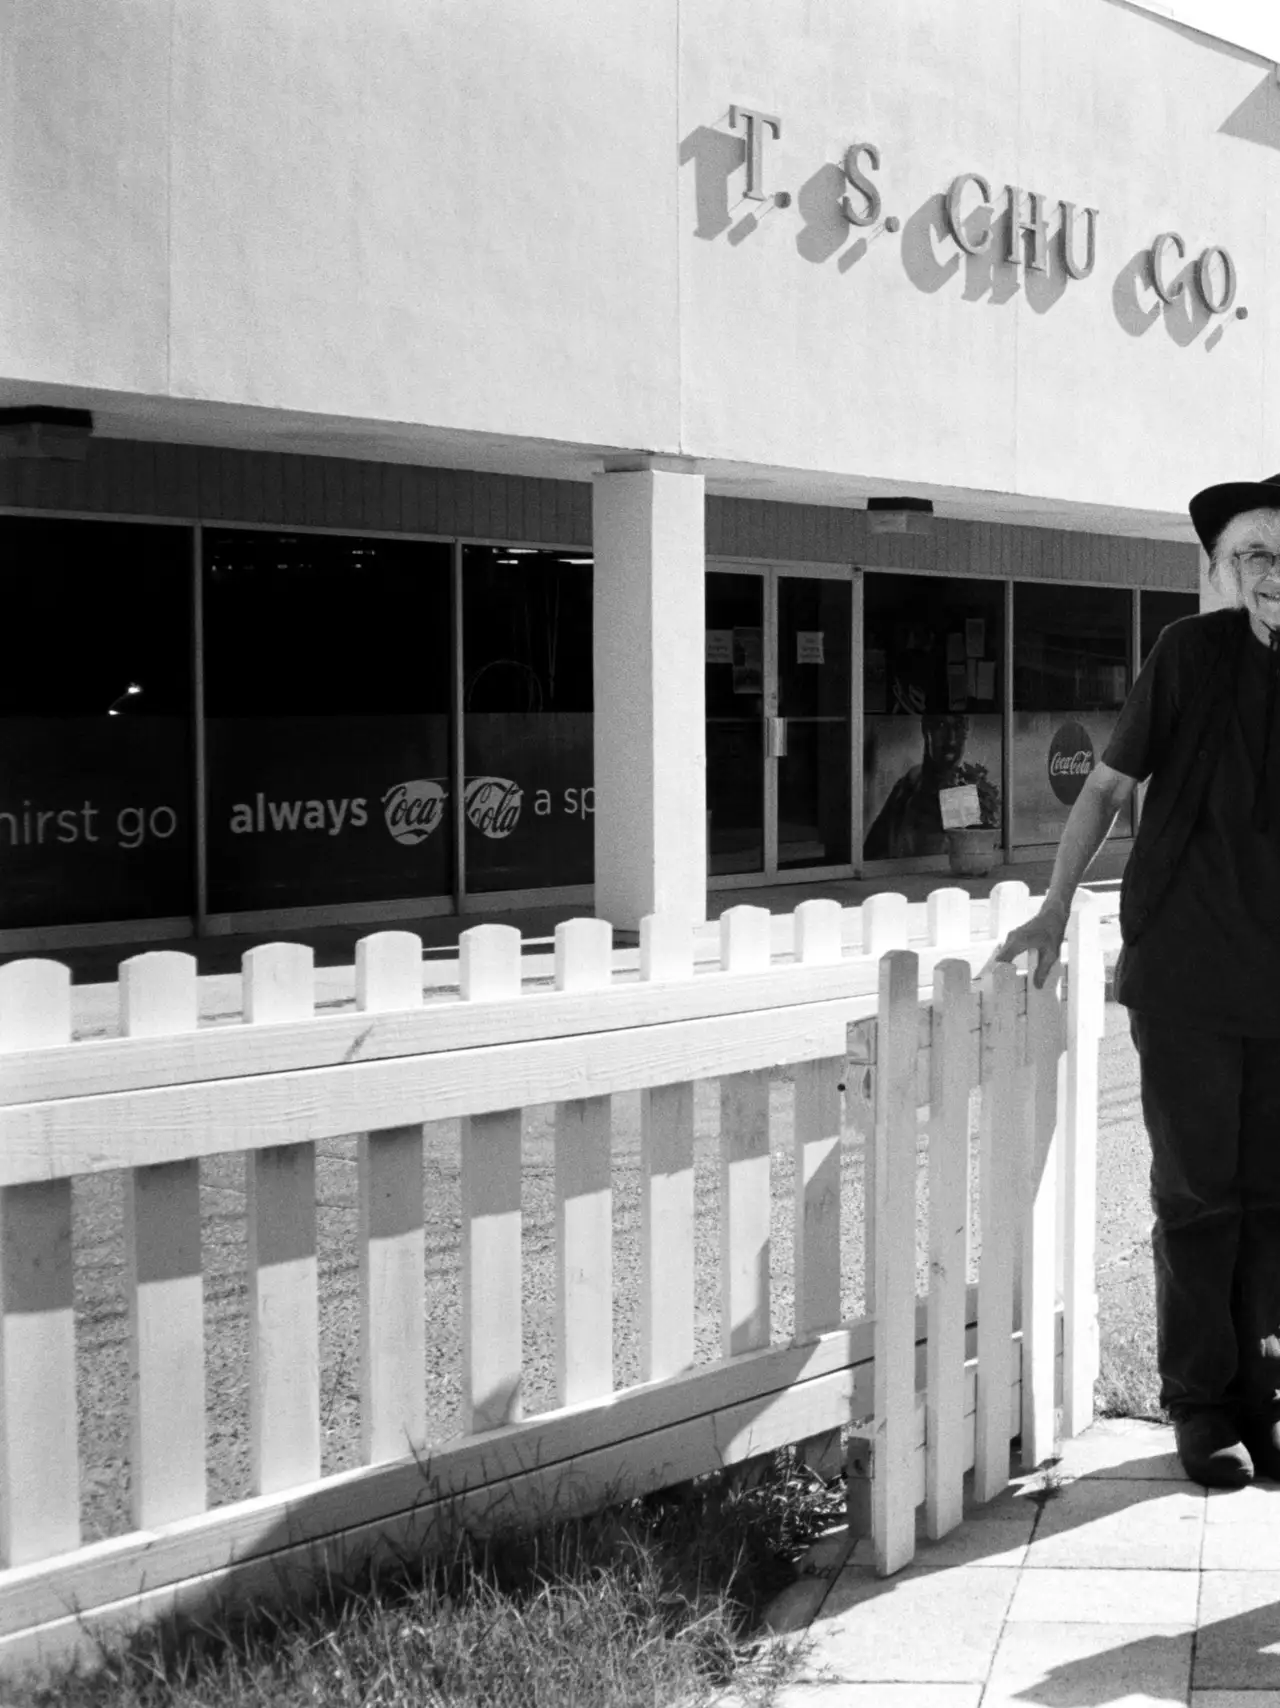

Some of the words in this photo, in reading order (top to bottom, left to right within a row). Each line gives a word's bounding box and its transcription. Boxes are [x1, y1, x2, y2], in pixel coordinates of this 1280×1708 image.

[728, 103, 791, 209] T.
[838, 142, 900, 234] S.
[943, 172, 1099, 280] CHU
[1149, 230, 1248, 321] CO.
[117, 805, 177, 848] go
[230, 792, 368, 836] always
[385, 785, 440, 828] Coca
[467, 782, 523, 834] Cola
[534, 788, 551, 815] a
